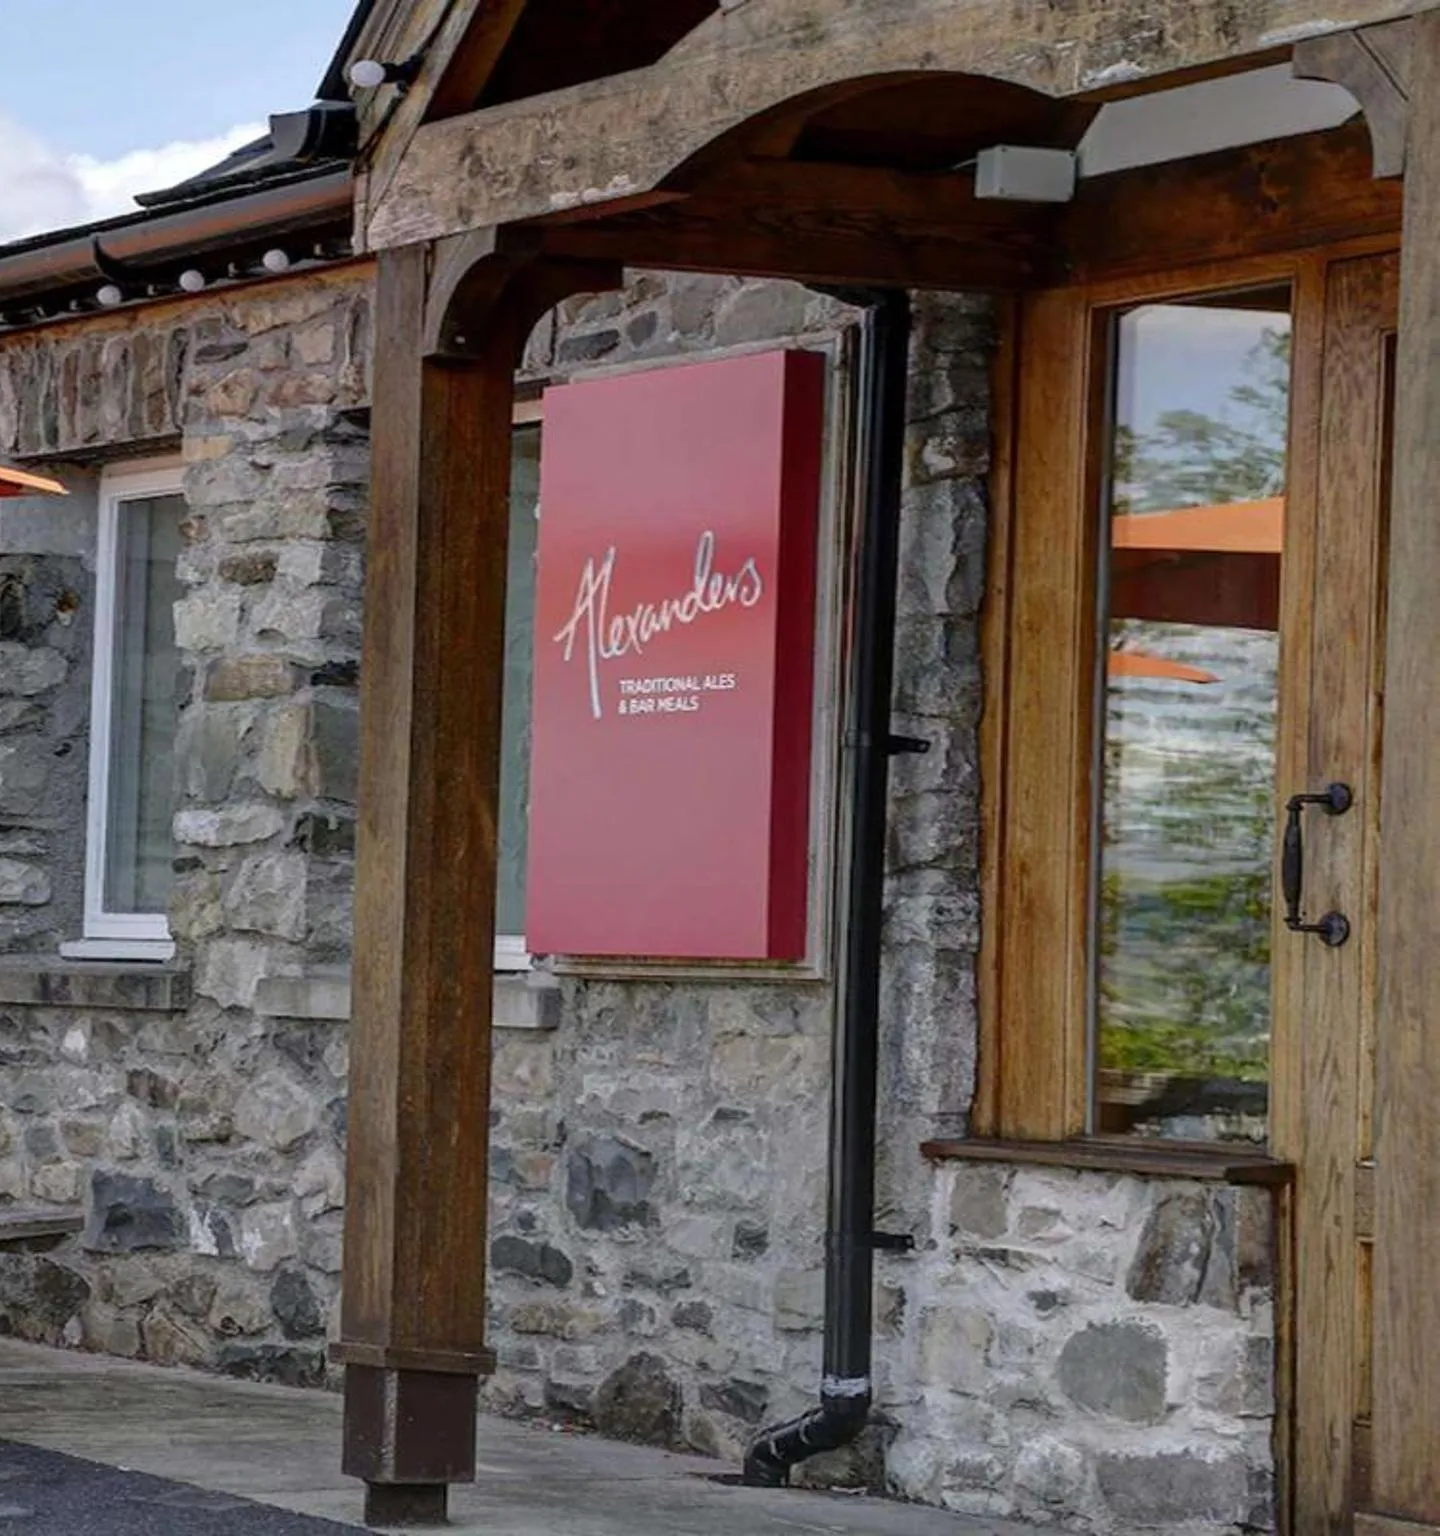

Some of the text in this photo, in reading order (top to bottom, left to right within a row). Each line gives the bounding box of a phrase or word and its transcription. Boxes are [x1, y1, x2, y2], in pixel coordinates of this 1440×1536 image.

[553, 530, 762, 719] Alexanders
[619, 673, 736, 694] TRADITIONAL ALES
[618, 696, 699, 714] & BAR MEALS
